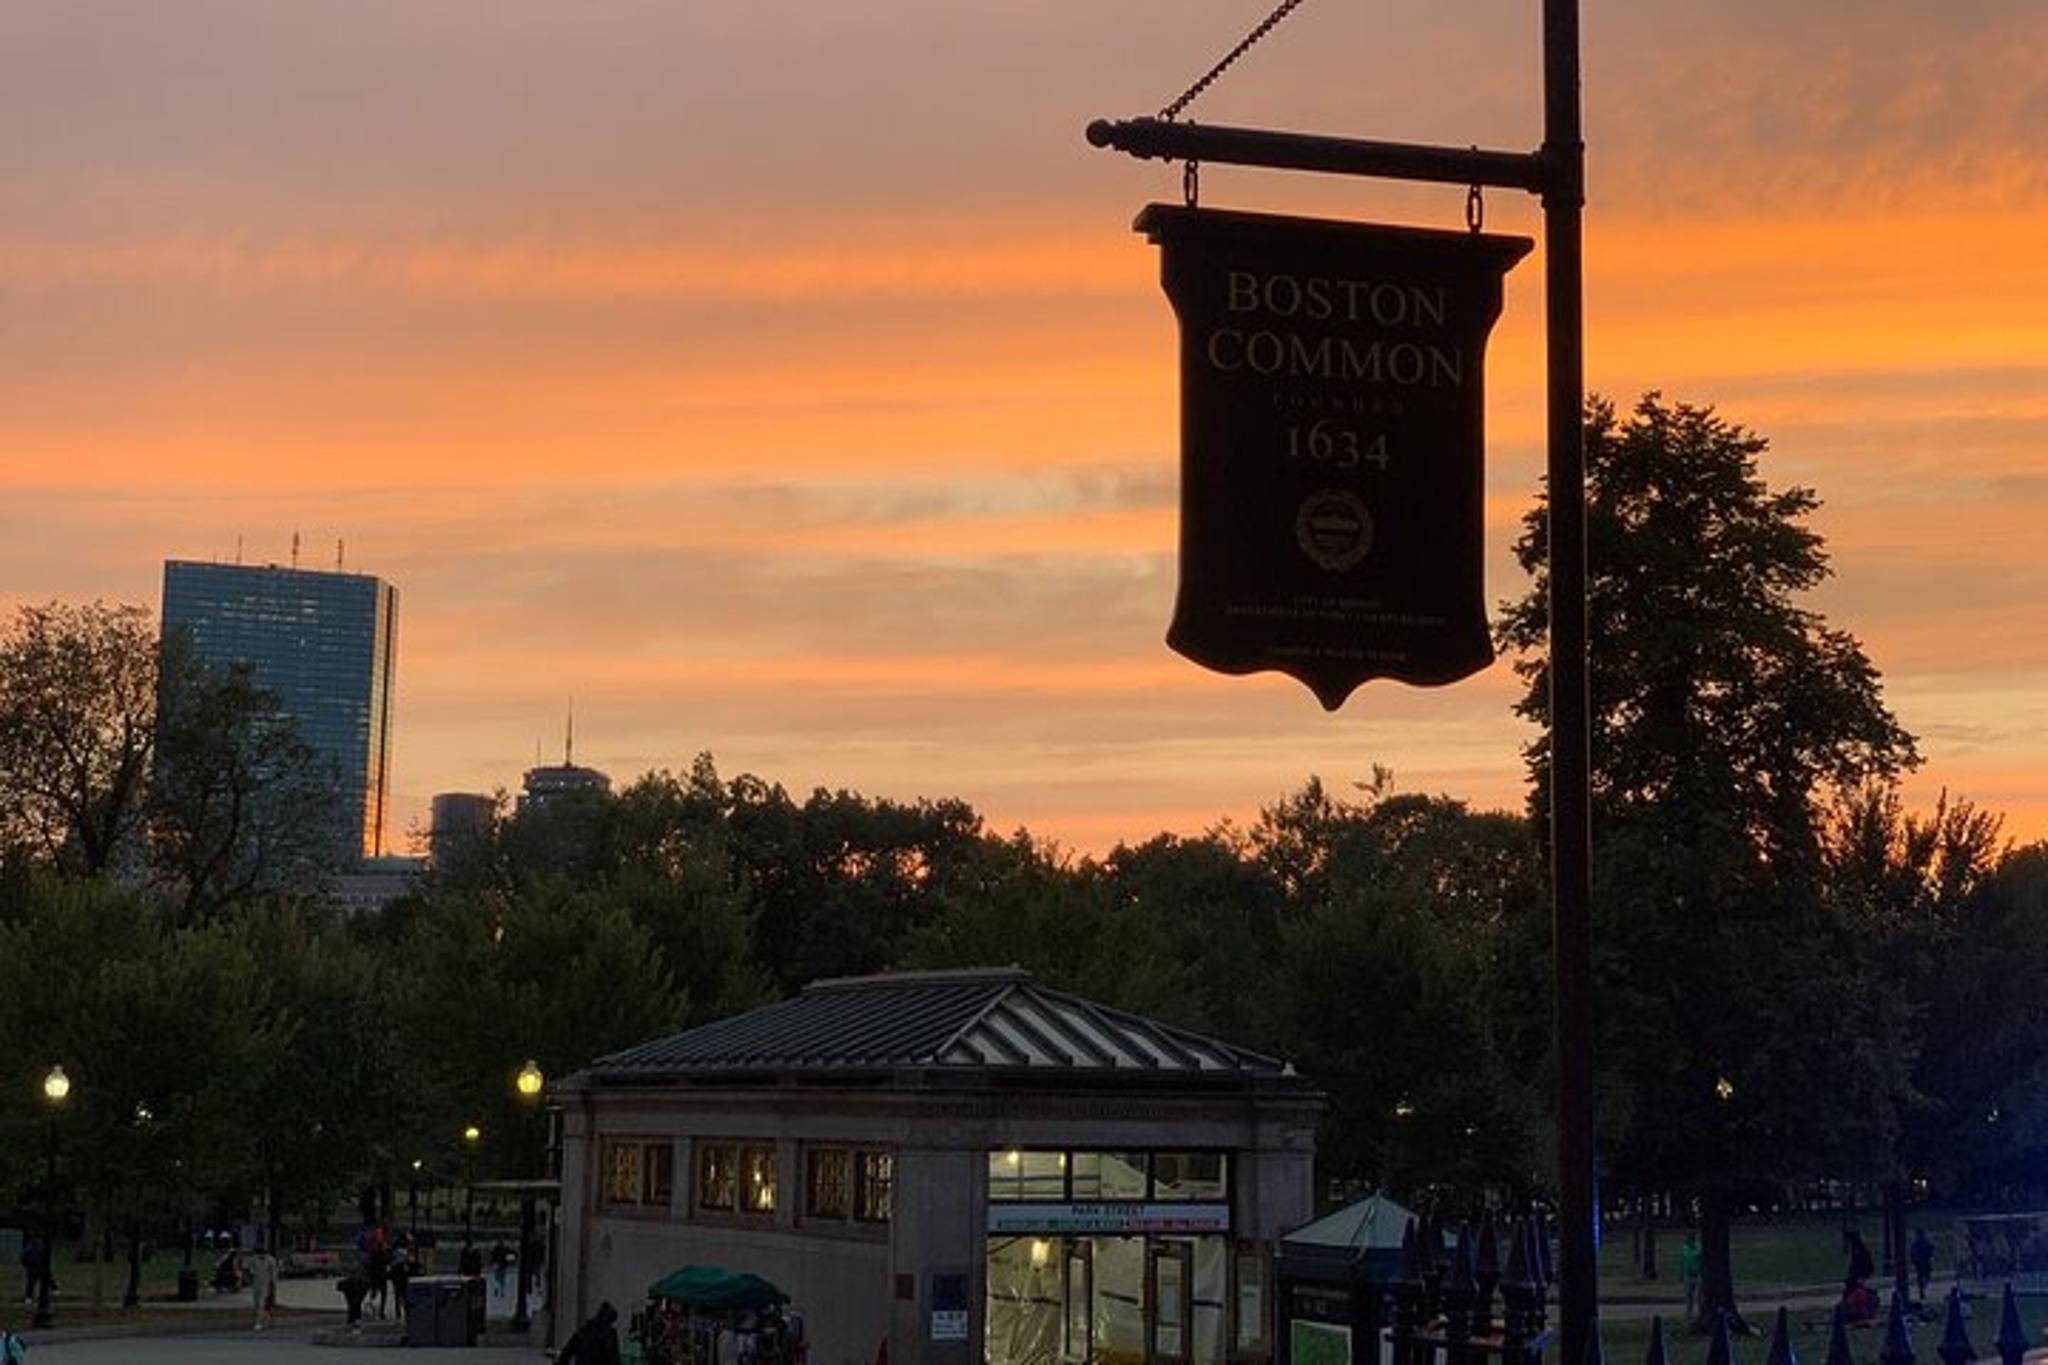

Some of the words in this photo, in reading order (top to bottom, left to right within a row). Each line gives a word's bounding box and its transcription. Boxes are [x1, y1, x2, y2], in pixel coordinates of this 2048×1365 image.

[1227, 271, 1447, 326] BOSTON
[1207, 328, 1464, 388] COMMON
[1289, 417, 1389, 470] 1634
